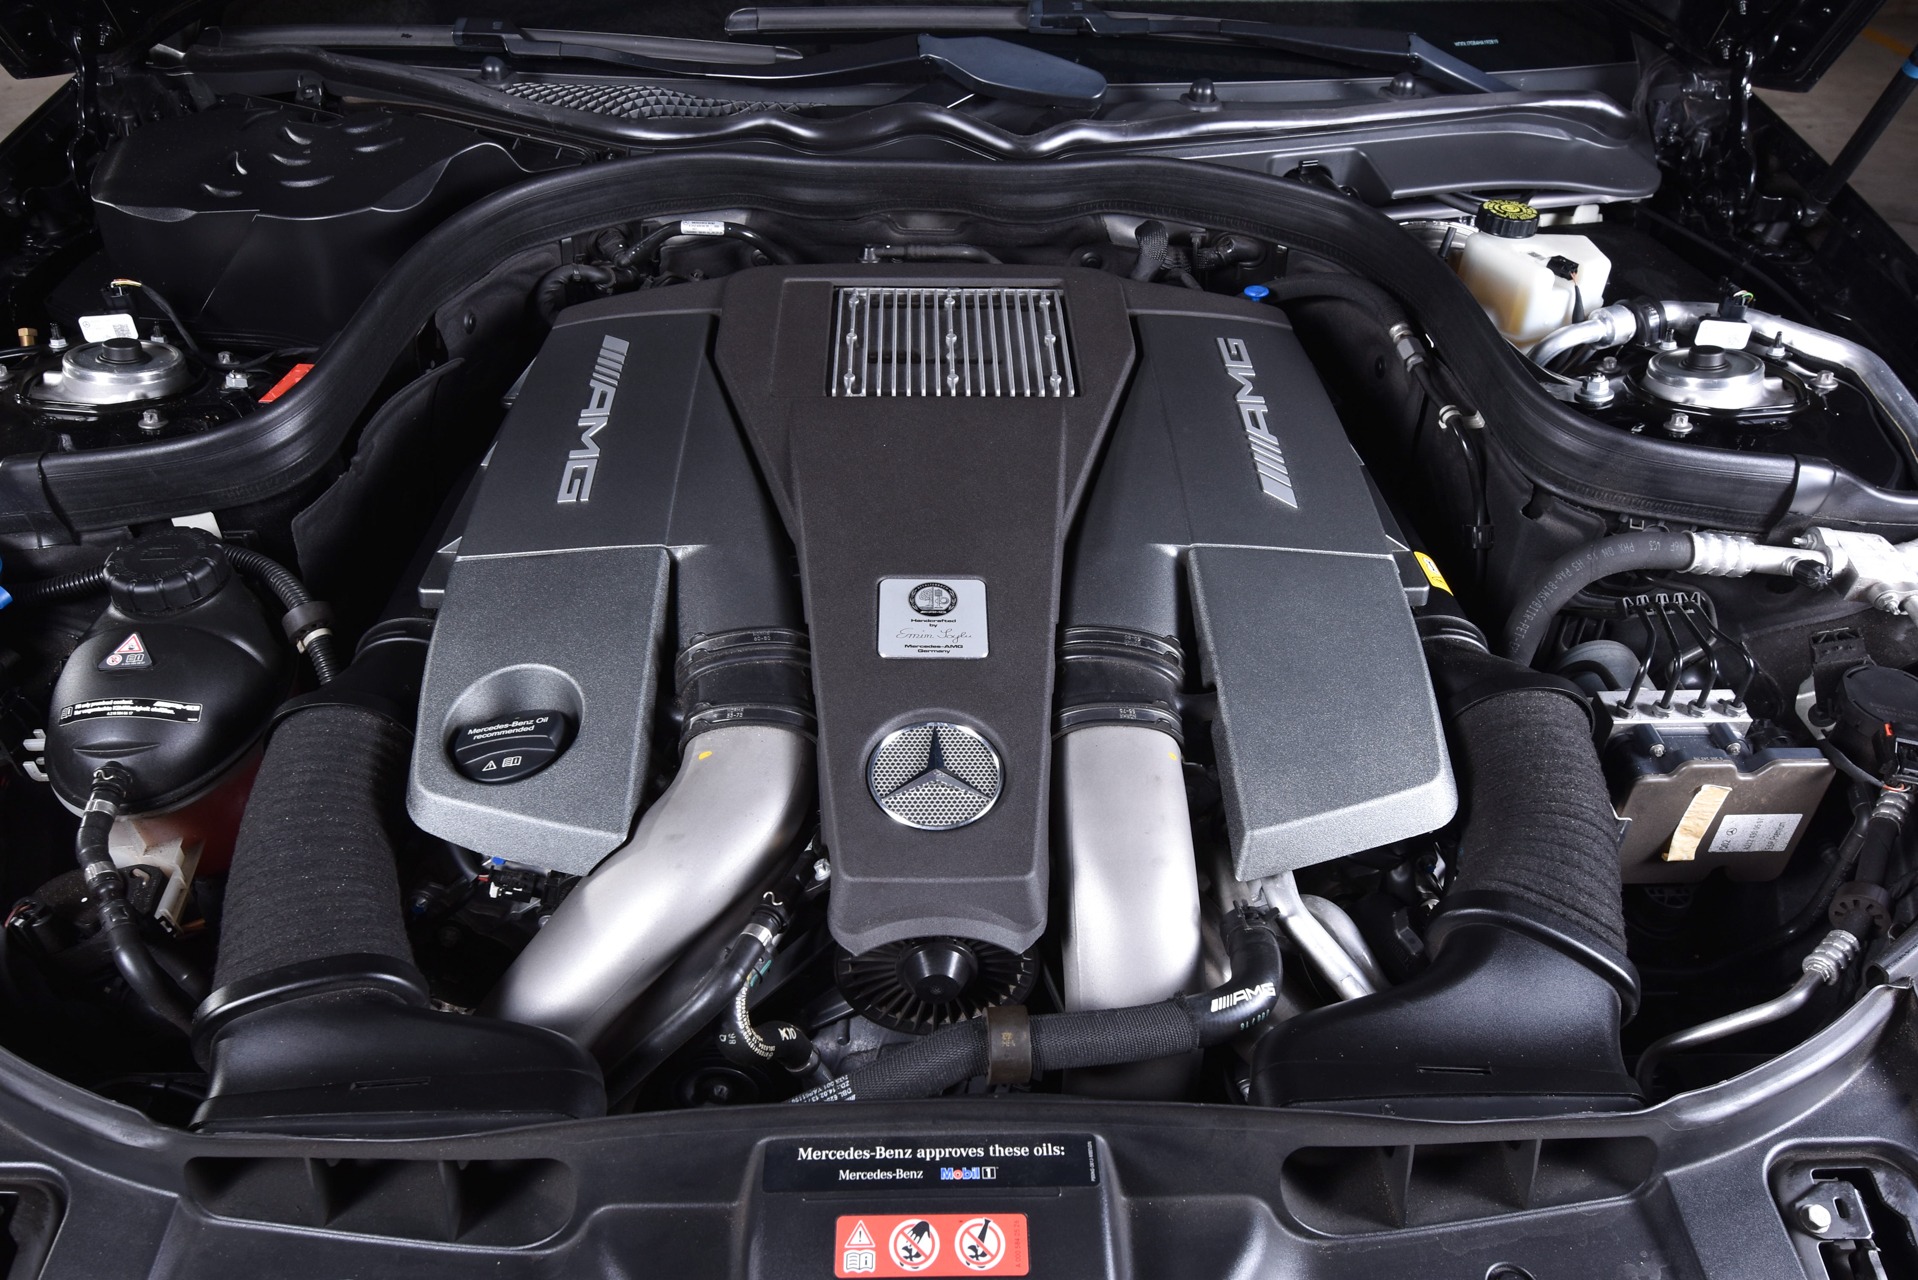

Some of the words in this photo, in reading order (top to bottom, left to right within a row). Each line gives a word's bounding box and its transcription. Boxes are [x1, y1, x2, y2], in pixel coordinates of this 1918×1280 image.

[467, 719, 534, 735] Mercedes-Benz
[473, 725, 535, 740] recommended
[797, 1146, 912, 1161] Mercedes-Benz
[916, 1147, 985, 1160] approves
[989, 1144, 1030, 1157] these
[1033, 1143, 1066, 1156] oils:
[838, 1168, 924, 1180] Mercedes-Benz
[940, 1167, 980, 1180] Mobil
